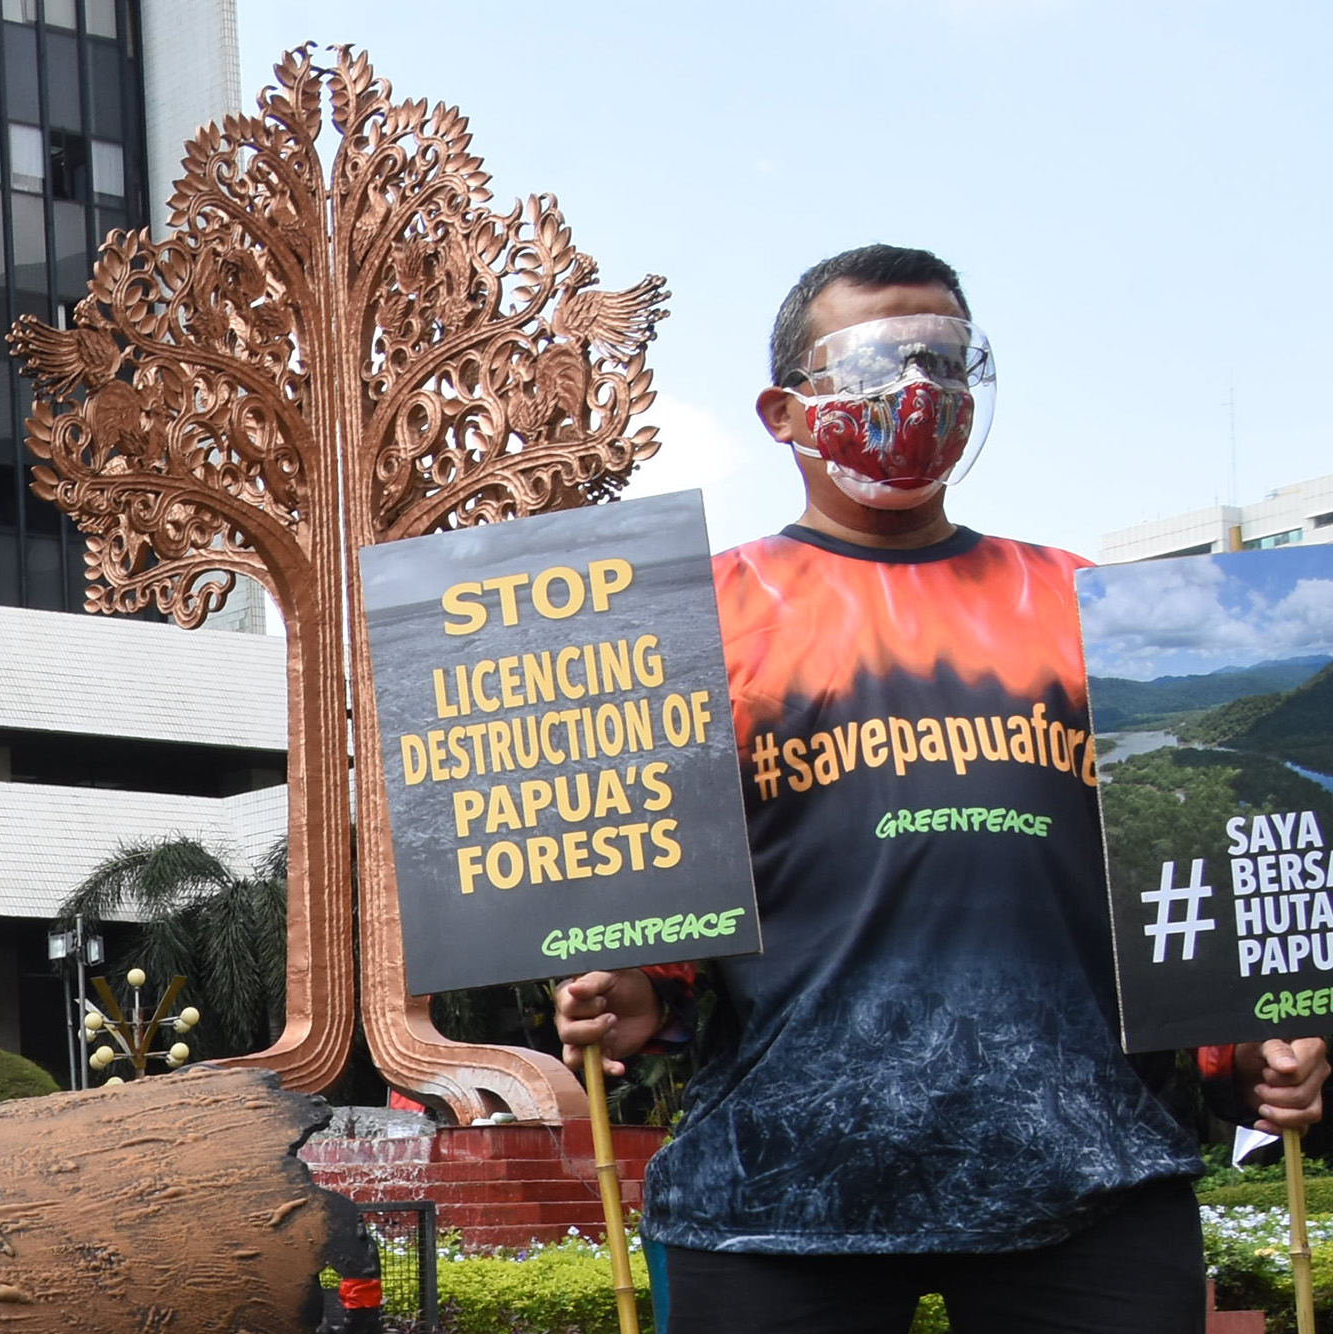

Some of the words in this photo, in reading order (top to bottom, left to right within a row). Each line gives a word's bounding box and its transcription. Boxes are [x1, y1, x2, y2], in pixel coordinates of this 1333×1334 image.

[441, 557, 634, 636] STOP
[433, 634, 664, 719] LICENCING
[400, 698, 653, 786] DESTRUCTION
[662, 690, 712, 748] OF
[453, 761, 673, 838] PAPUA'S
[875, 807, 1052, 839] GREENPEACE
[1225, 811, 1324, 856] SAYA
[457, 818, 682, 894] FORESTS
[541, 907, 745, 960] GREENPEACE
[1140, 858, 1216, 963] #
[1234, 891, 1333, 936] HUTA
[1254, 987, 1333, 1024] GREE
